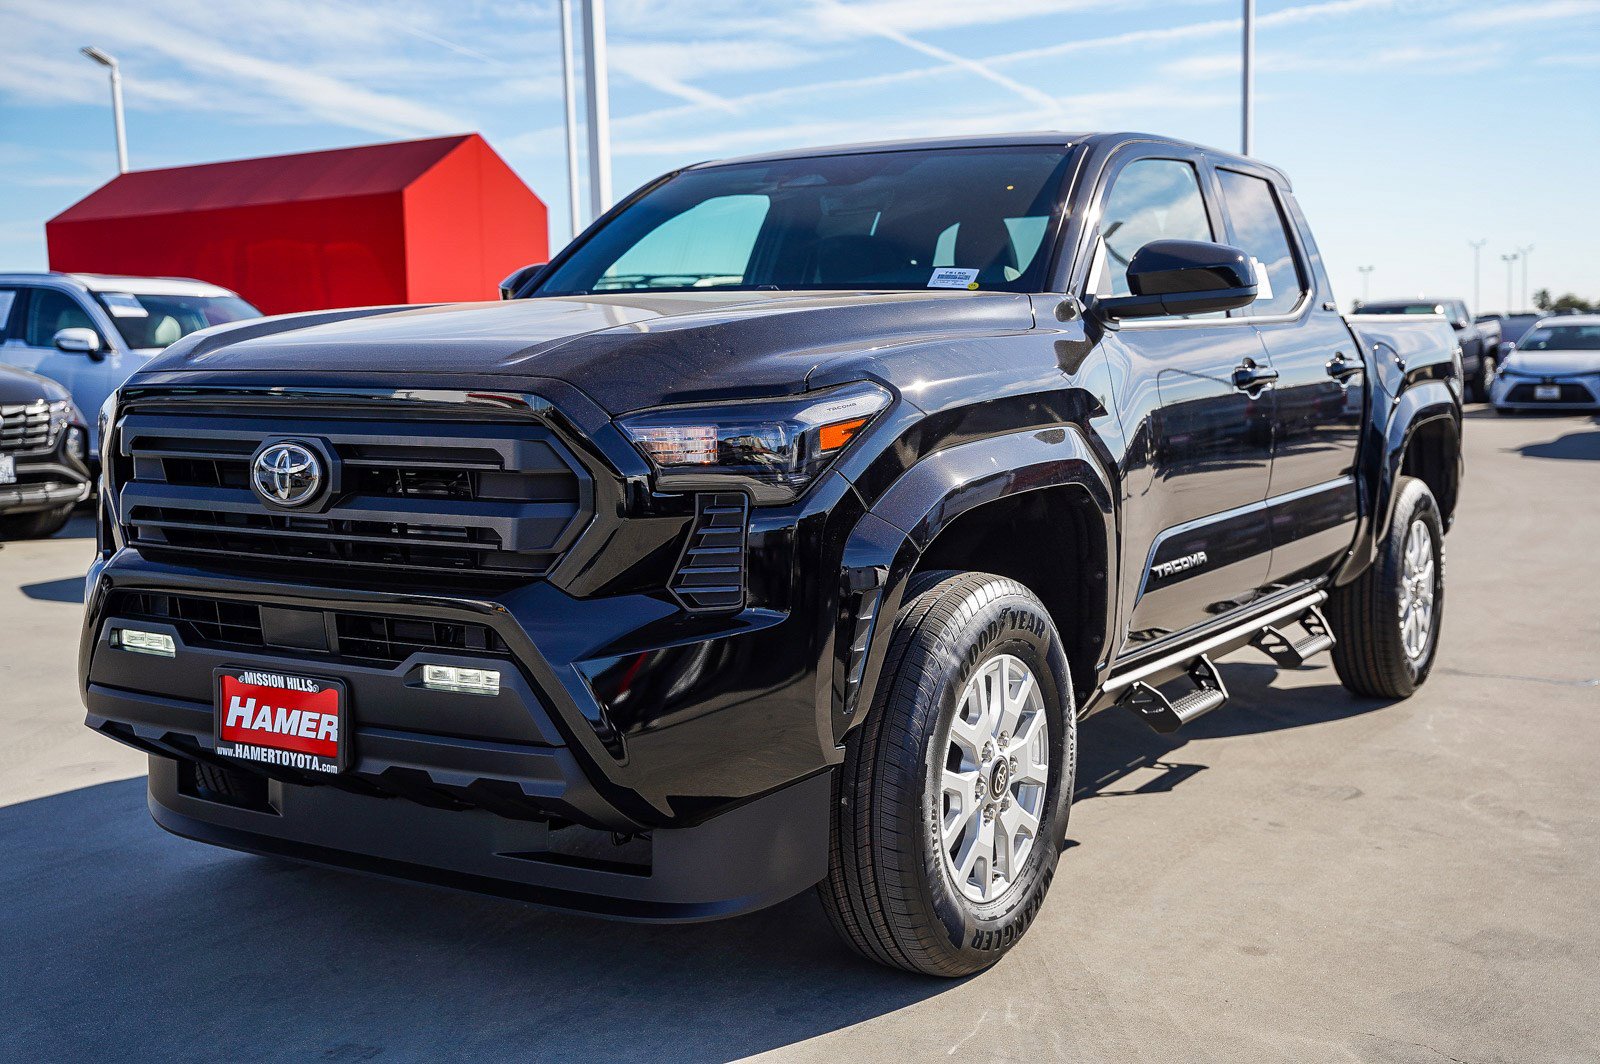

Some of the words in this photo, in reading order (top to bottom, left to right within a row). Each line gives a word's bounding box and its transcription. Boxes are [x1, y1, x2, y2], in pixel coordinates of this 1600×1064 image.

[826, 402, 857, 412] TACOMA
[1149, 551, 1208, 578] TACOMA
[244, 671, 285, 689] MISSION
[286, 676, 314, 693] HILLS
[225, 695, 339, 742] HAMER
[216, 743, 338, 774] www.HAMERTOYOTA.com
[971, 867, 1054, 951] WRANGLER
